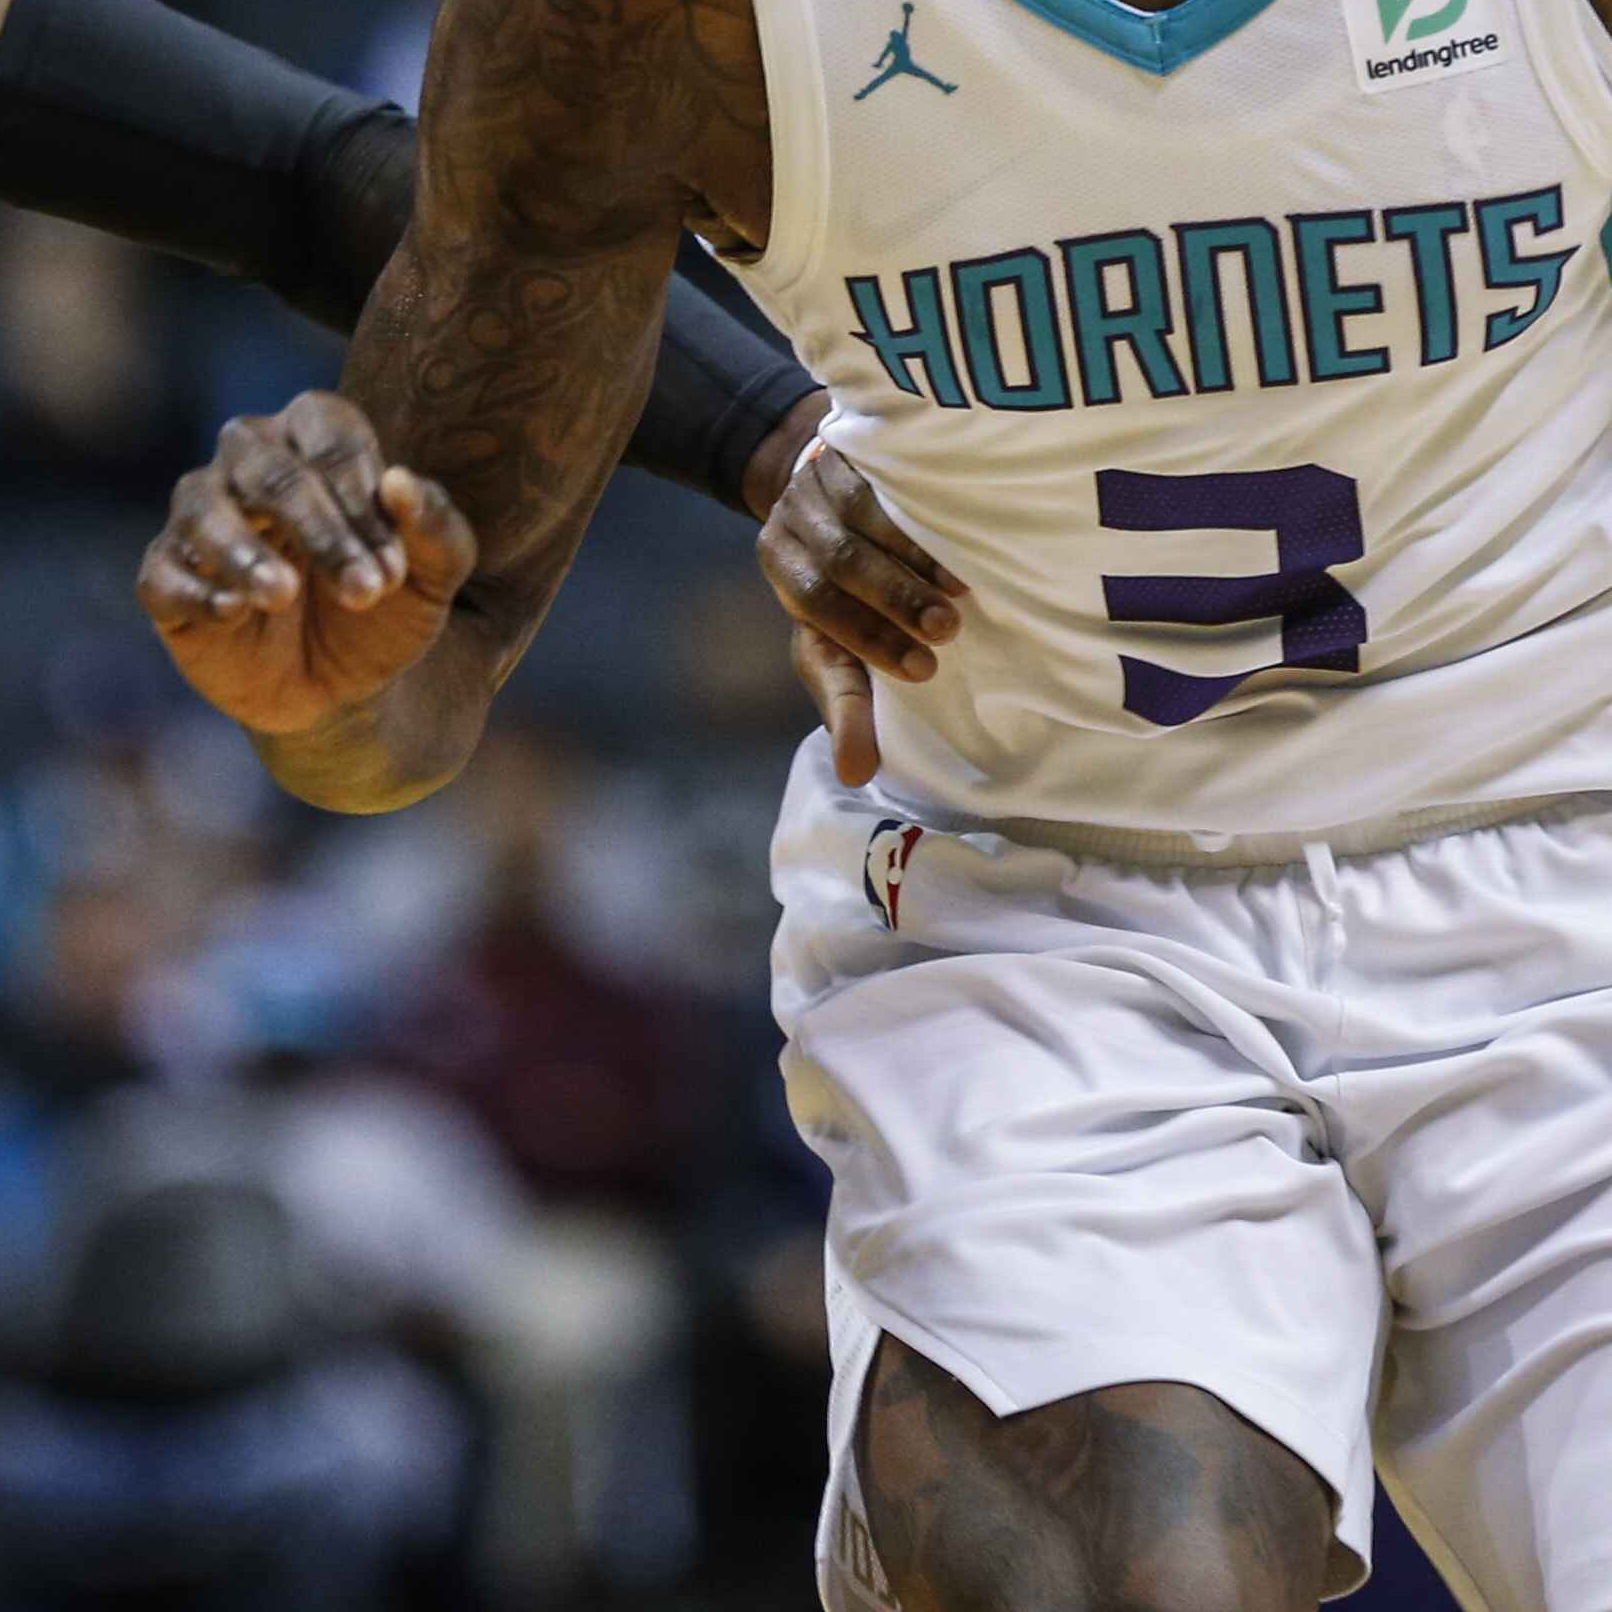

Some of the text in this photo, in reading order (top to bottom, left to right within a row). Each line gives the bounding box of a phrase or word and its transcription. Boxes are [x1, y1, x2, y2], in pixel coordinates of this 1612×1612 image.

[1365, 33, 1498, 80] lendingtree
[844, 183, 1581, 411] HORNETS
[1095, 463, 1368, 727] 3
